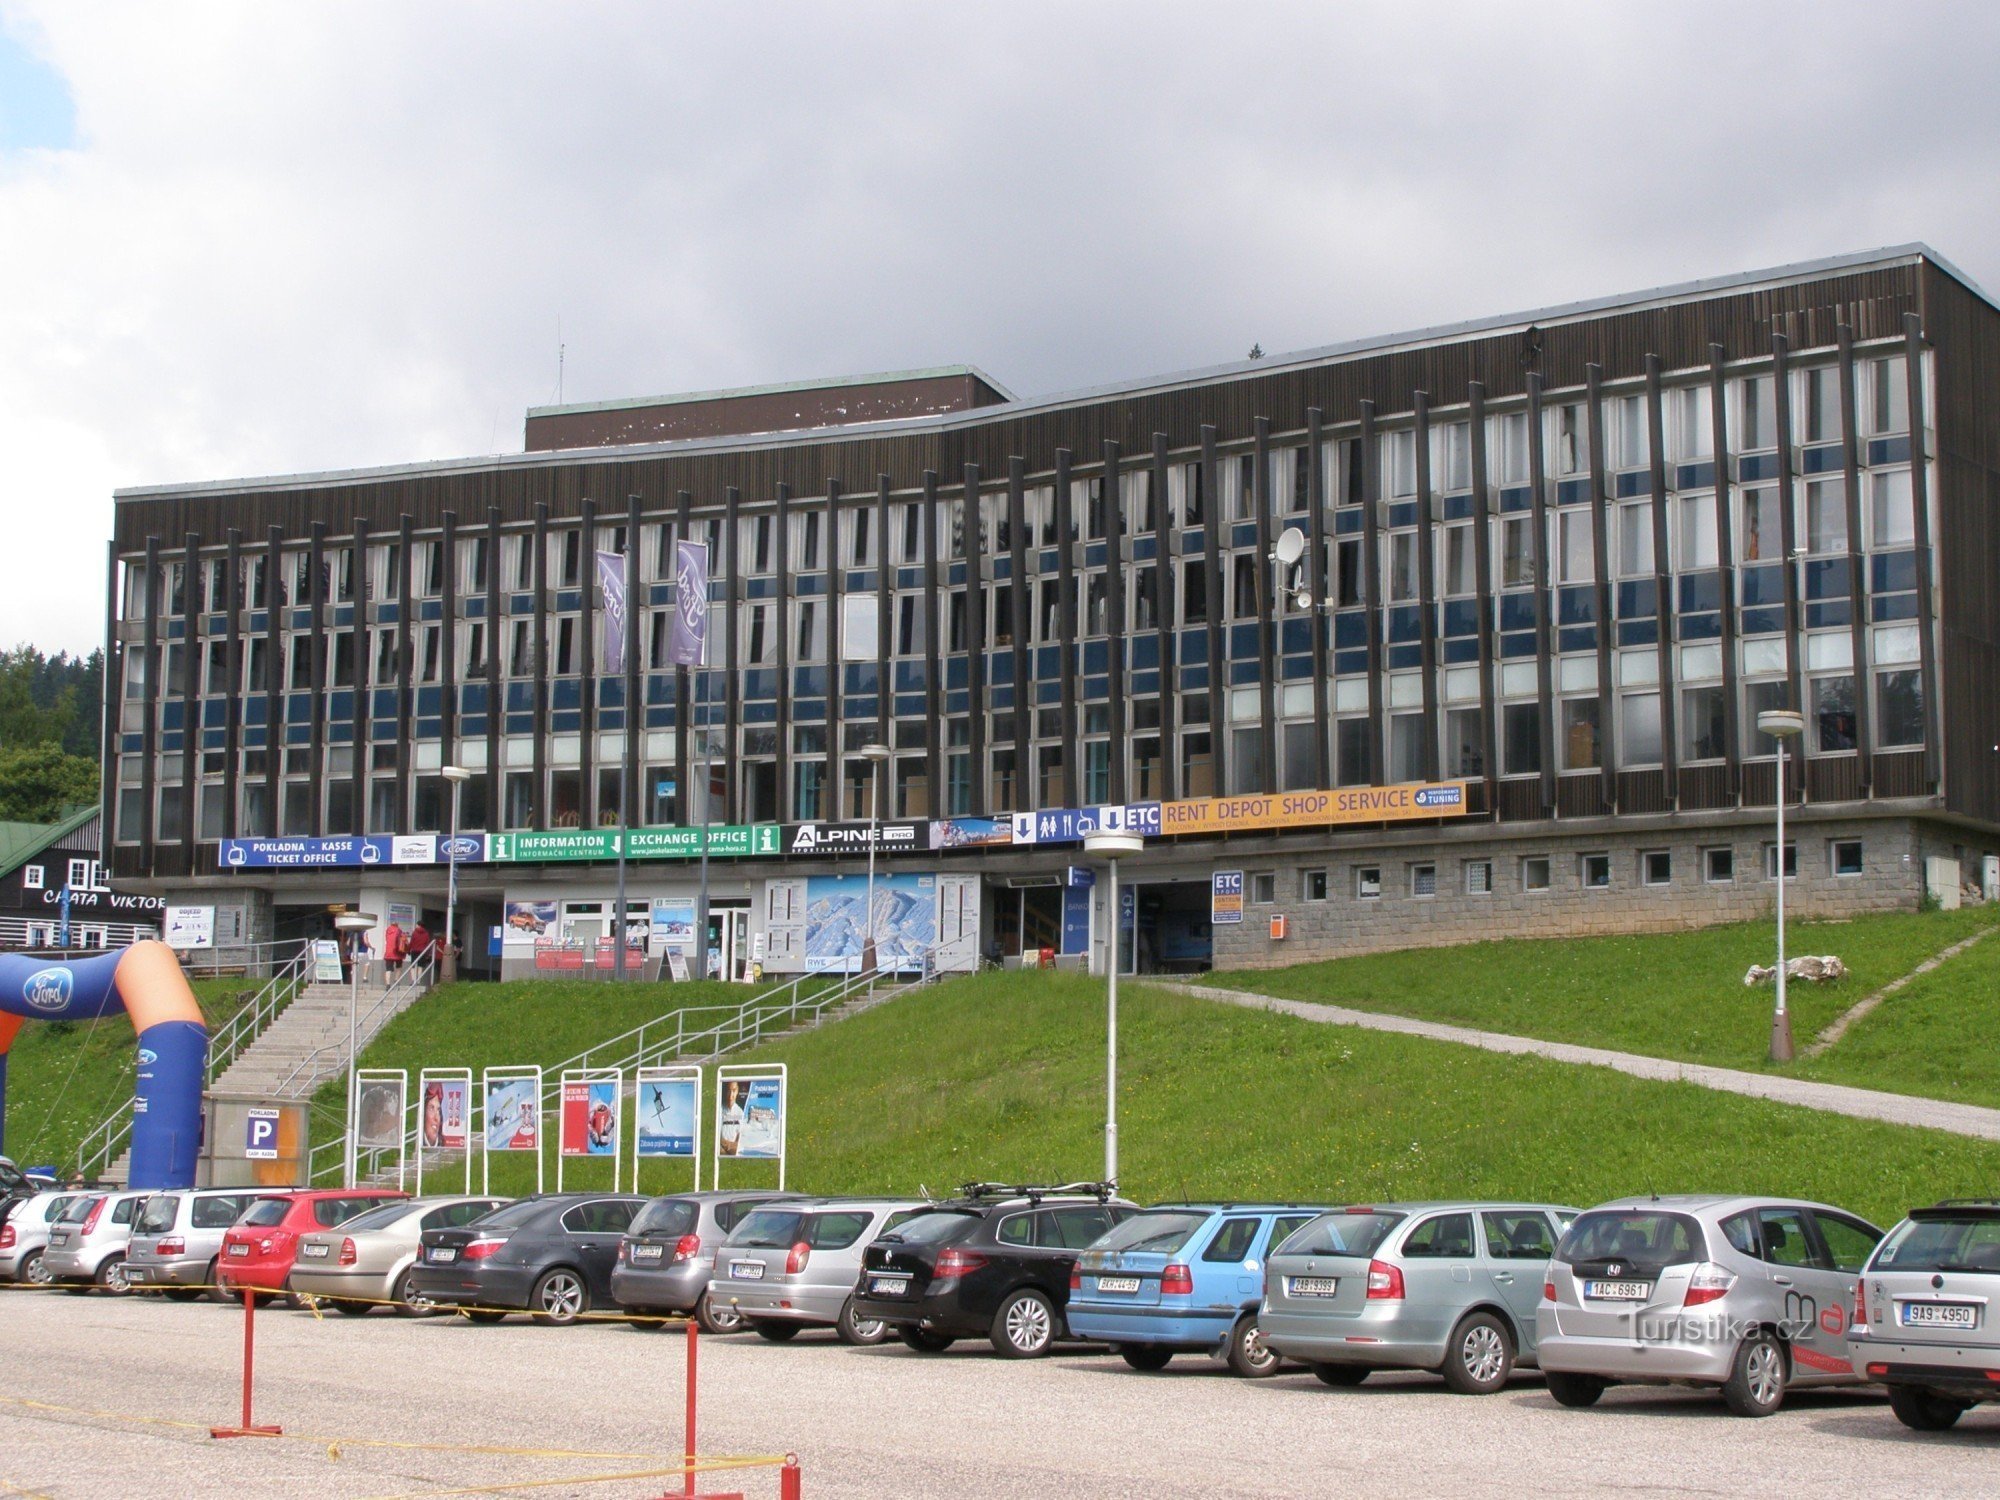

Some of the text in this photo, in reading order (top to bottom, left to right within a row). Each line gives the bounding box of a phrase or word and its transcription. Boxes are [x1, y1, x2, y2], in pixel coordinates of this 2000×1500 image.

[1428, 794, 1460, 804] TUNING
[1167, 790, 1409, 822] RENT DEPOT SHOP SERVICE
[1127, 807, 1158, 826] ETC
[792, 825, 880, 847] ALPINE
[1128, 826, 1158, 834] ORT
[520, 836, 605, 848] INFORMATION
[631, 833, 697, 845] EXCHANGE
[253, 843, 305, 852] POKLADNA
[321, 842, 353, 851] KASSE
[447, 840, 473, 853] Ford
[520, 849, 566, 857] INFORMAČNÍ
[267, 853, 337, 863] TICKET OFFICE
[1216, 874, 1240, 888] ETC
[32, 973, 62, 1003] Ford
[253, 1120, 272, 1145] P
[1595, 1282, 1642, 1296] 1AC 6961
[1912, 1306, 1970, 1322] 9A9 4950
